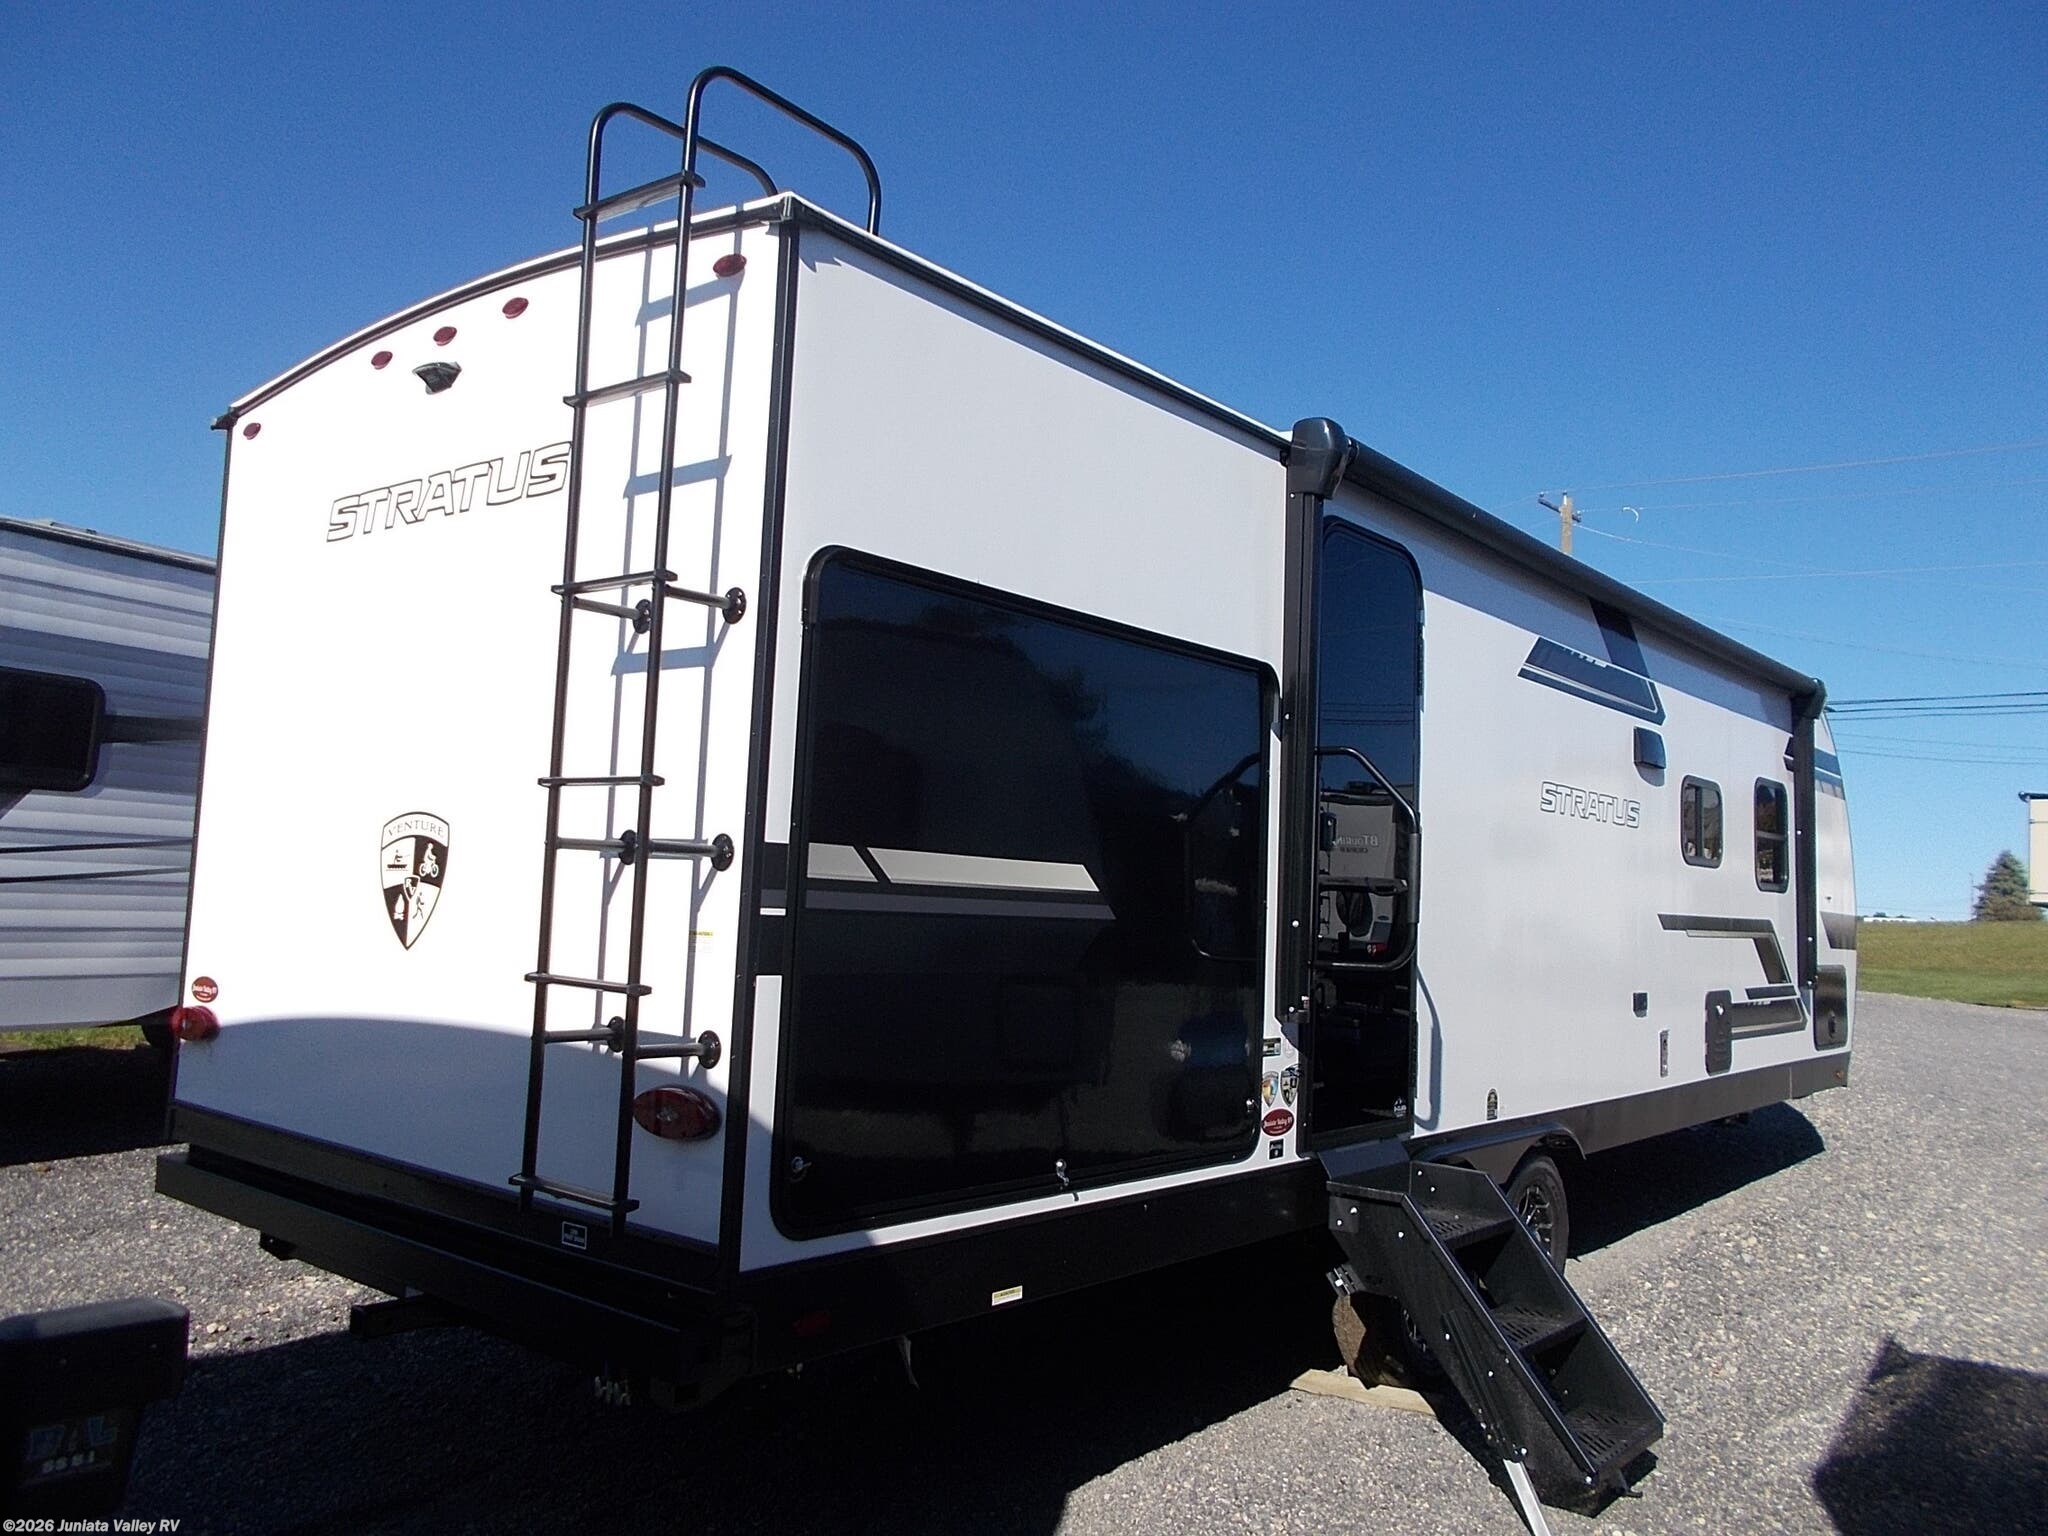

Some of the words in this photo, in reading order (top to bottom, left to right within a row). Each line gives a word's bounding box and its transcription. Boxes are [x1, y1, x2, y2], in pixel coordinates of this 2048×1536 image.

[326, 440, 572, 543] STRATUS
[388, 820, 444, 836] VENTURE
[1540, 781, 1640, 829] STRATUS
